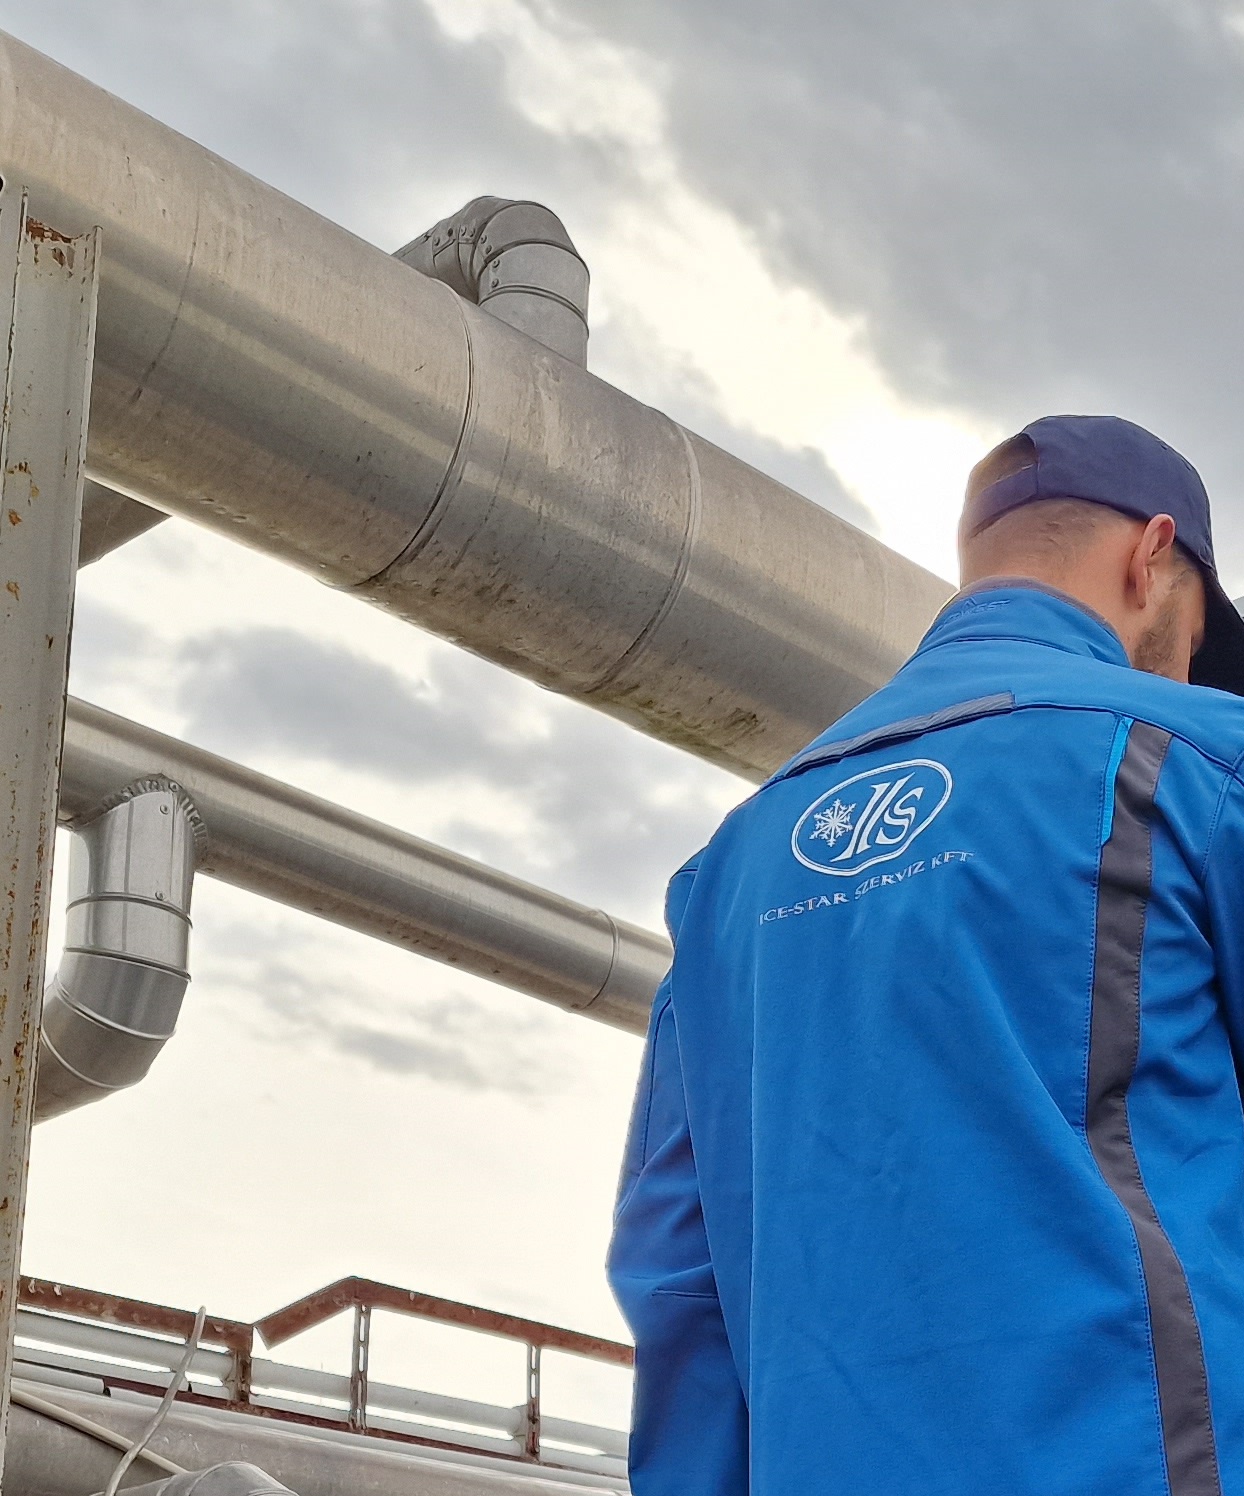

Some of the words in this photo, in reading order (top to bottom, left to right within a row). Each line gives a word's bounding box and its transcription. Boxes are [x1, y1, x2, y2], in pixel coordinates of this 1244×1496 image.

[759, 892, 849, 925] ICE-STAR
[854, 860, 925, 900] SZERVIZ
[931, 851, 975, 869] KFT
